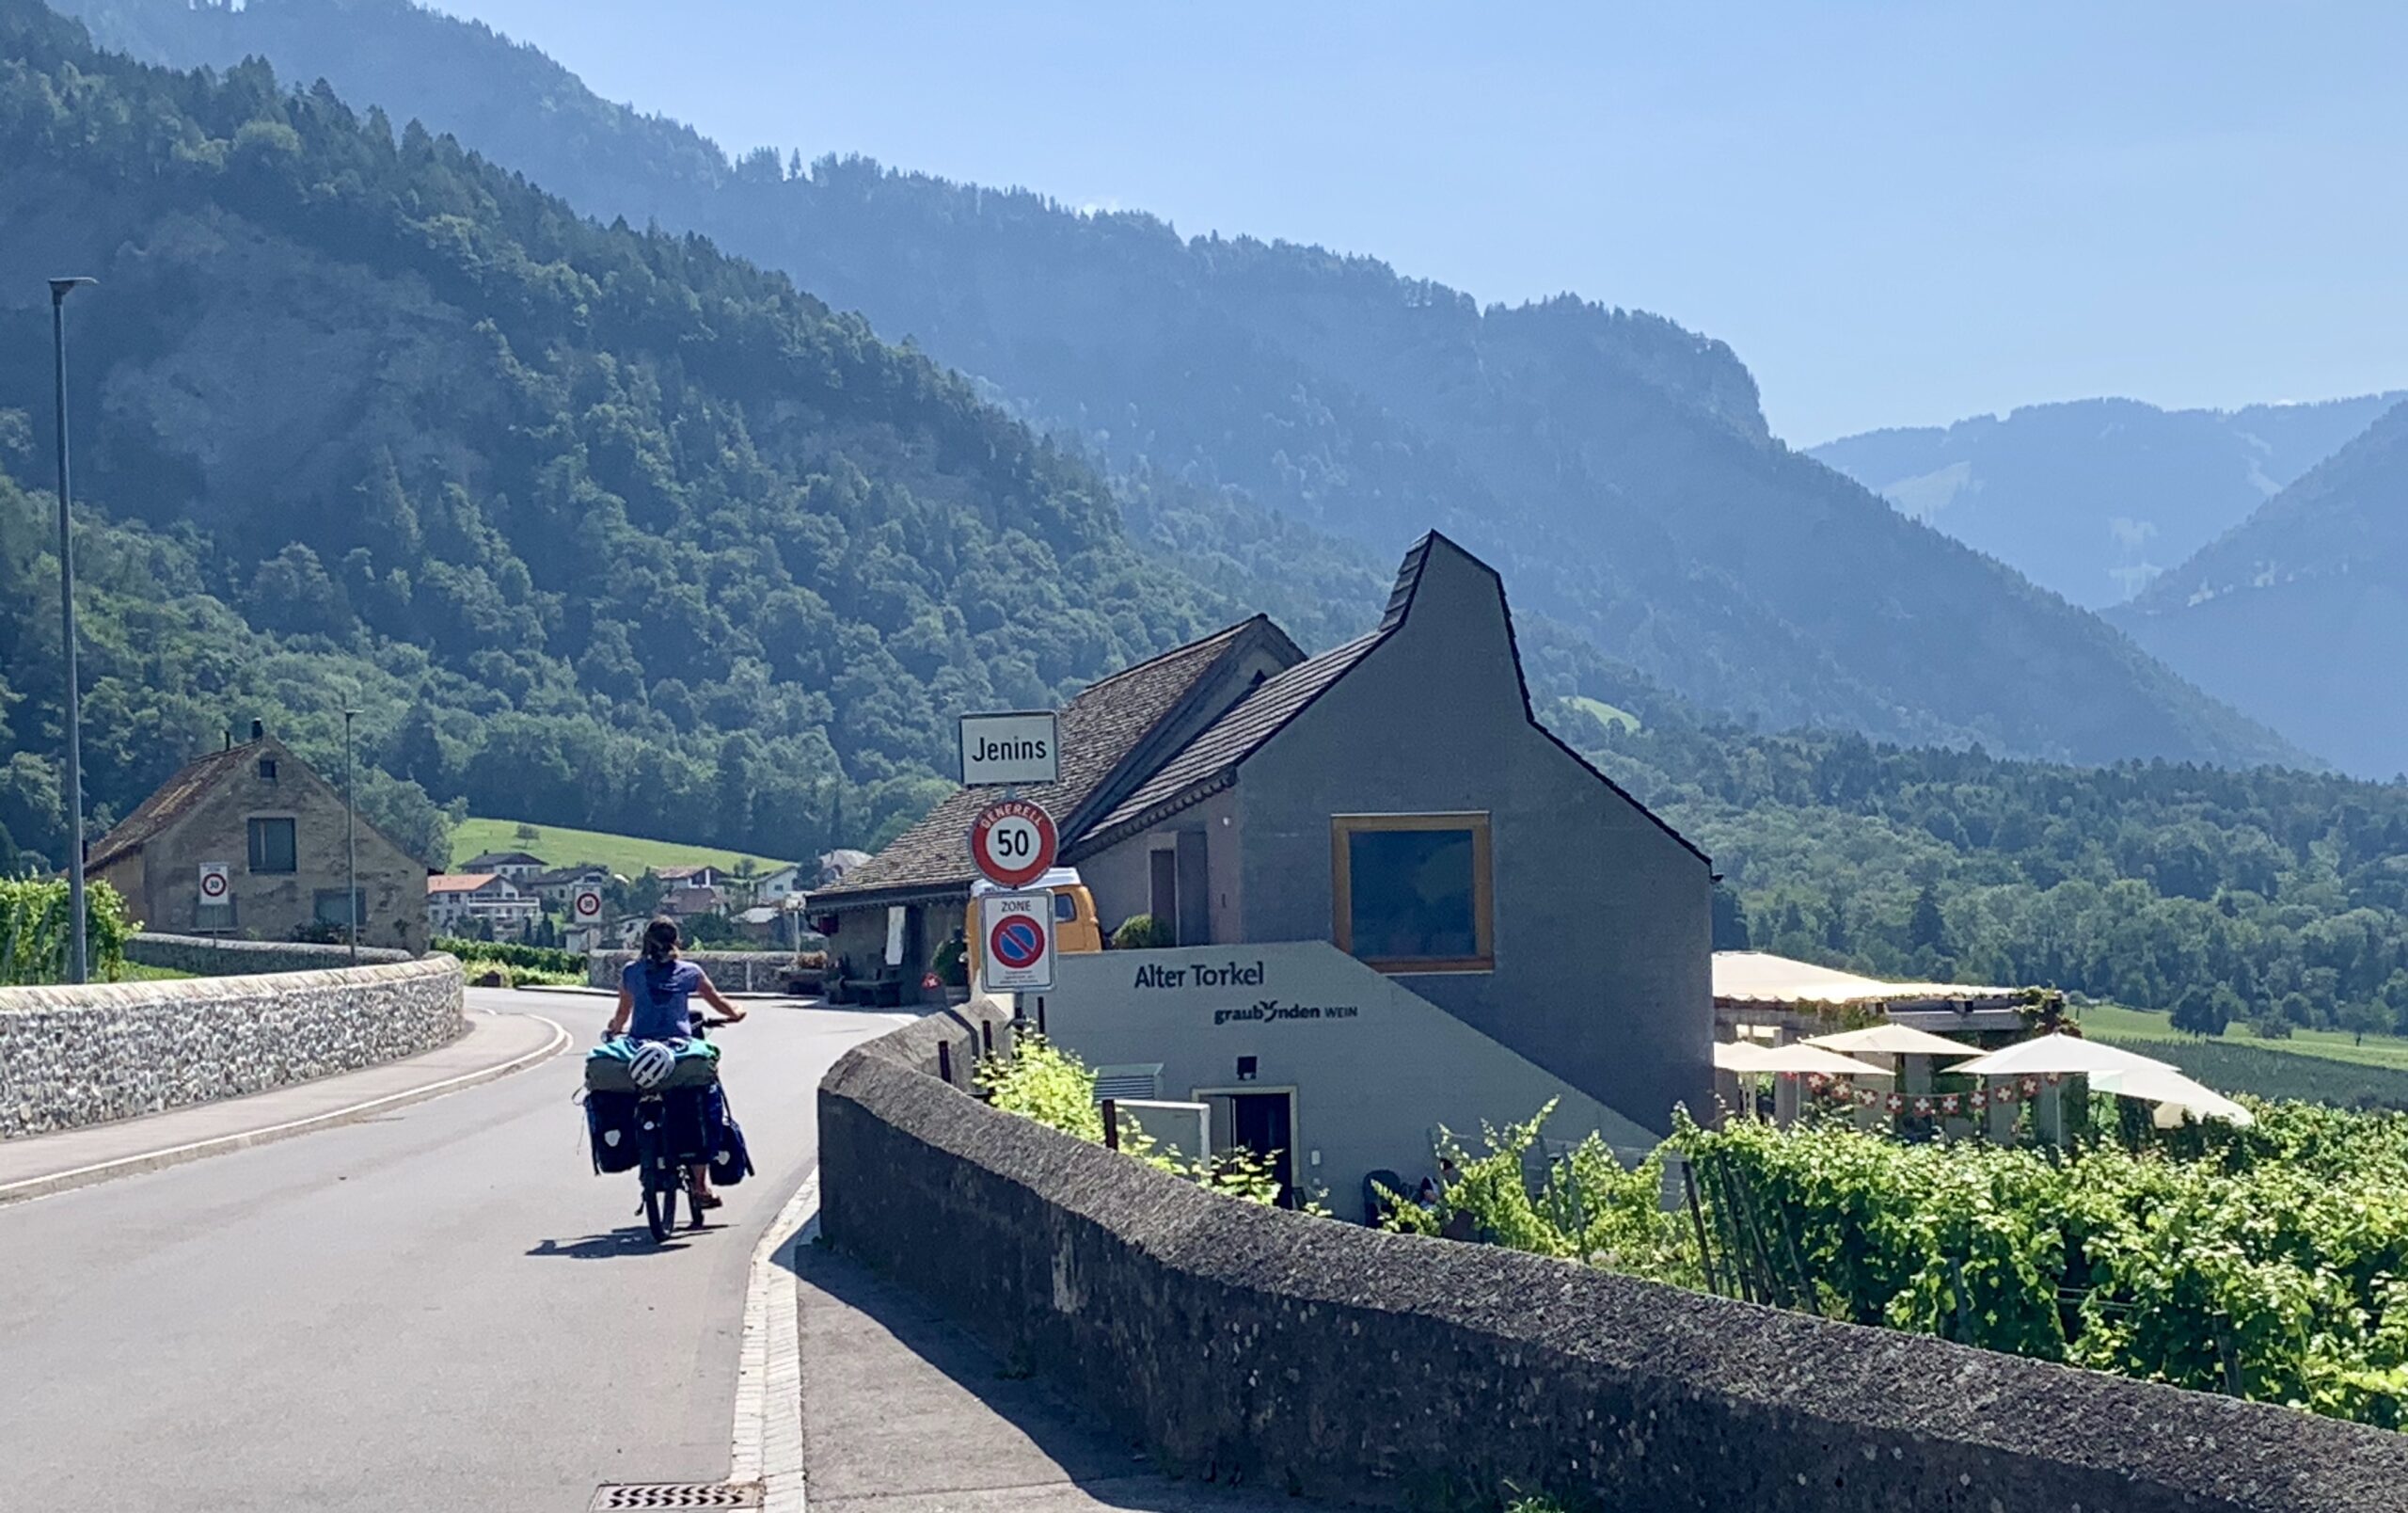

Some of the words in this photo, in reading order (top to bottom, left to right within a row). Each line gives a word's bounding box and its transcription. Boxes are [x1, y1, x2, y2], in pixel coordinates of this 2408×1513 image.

[972, 736, 1047, 762] Jenins
[980, 803, 1045, 830] GENERELL
[997, 829, 1029, 857] 50
[1001, 900, 1032, 913] ZONE
[1134, 964, 1186, 988] Alter
[1191, 961, 1264, 987] Torkel
[1324, 1007, 1358, 1019] WEIN
